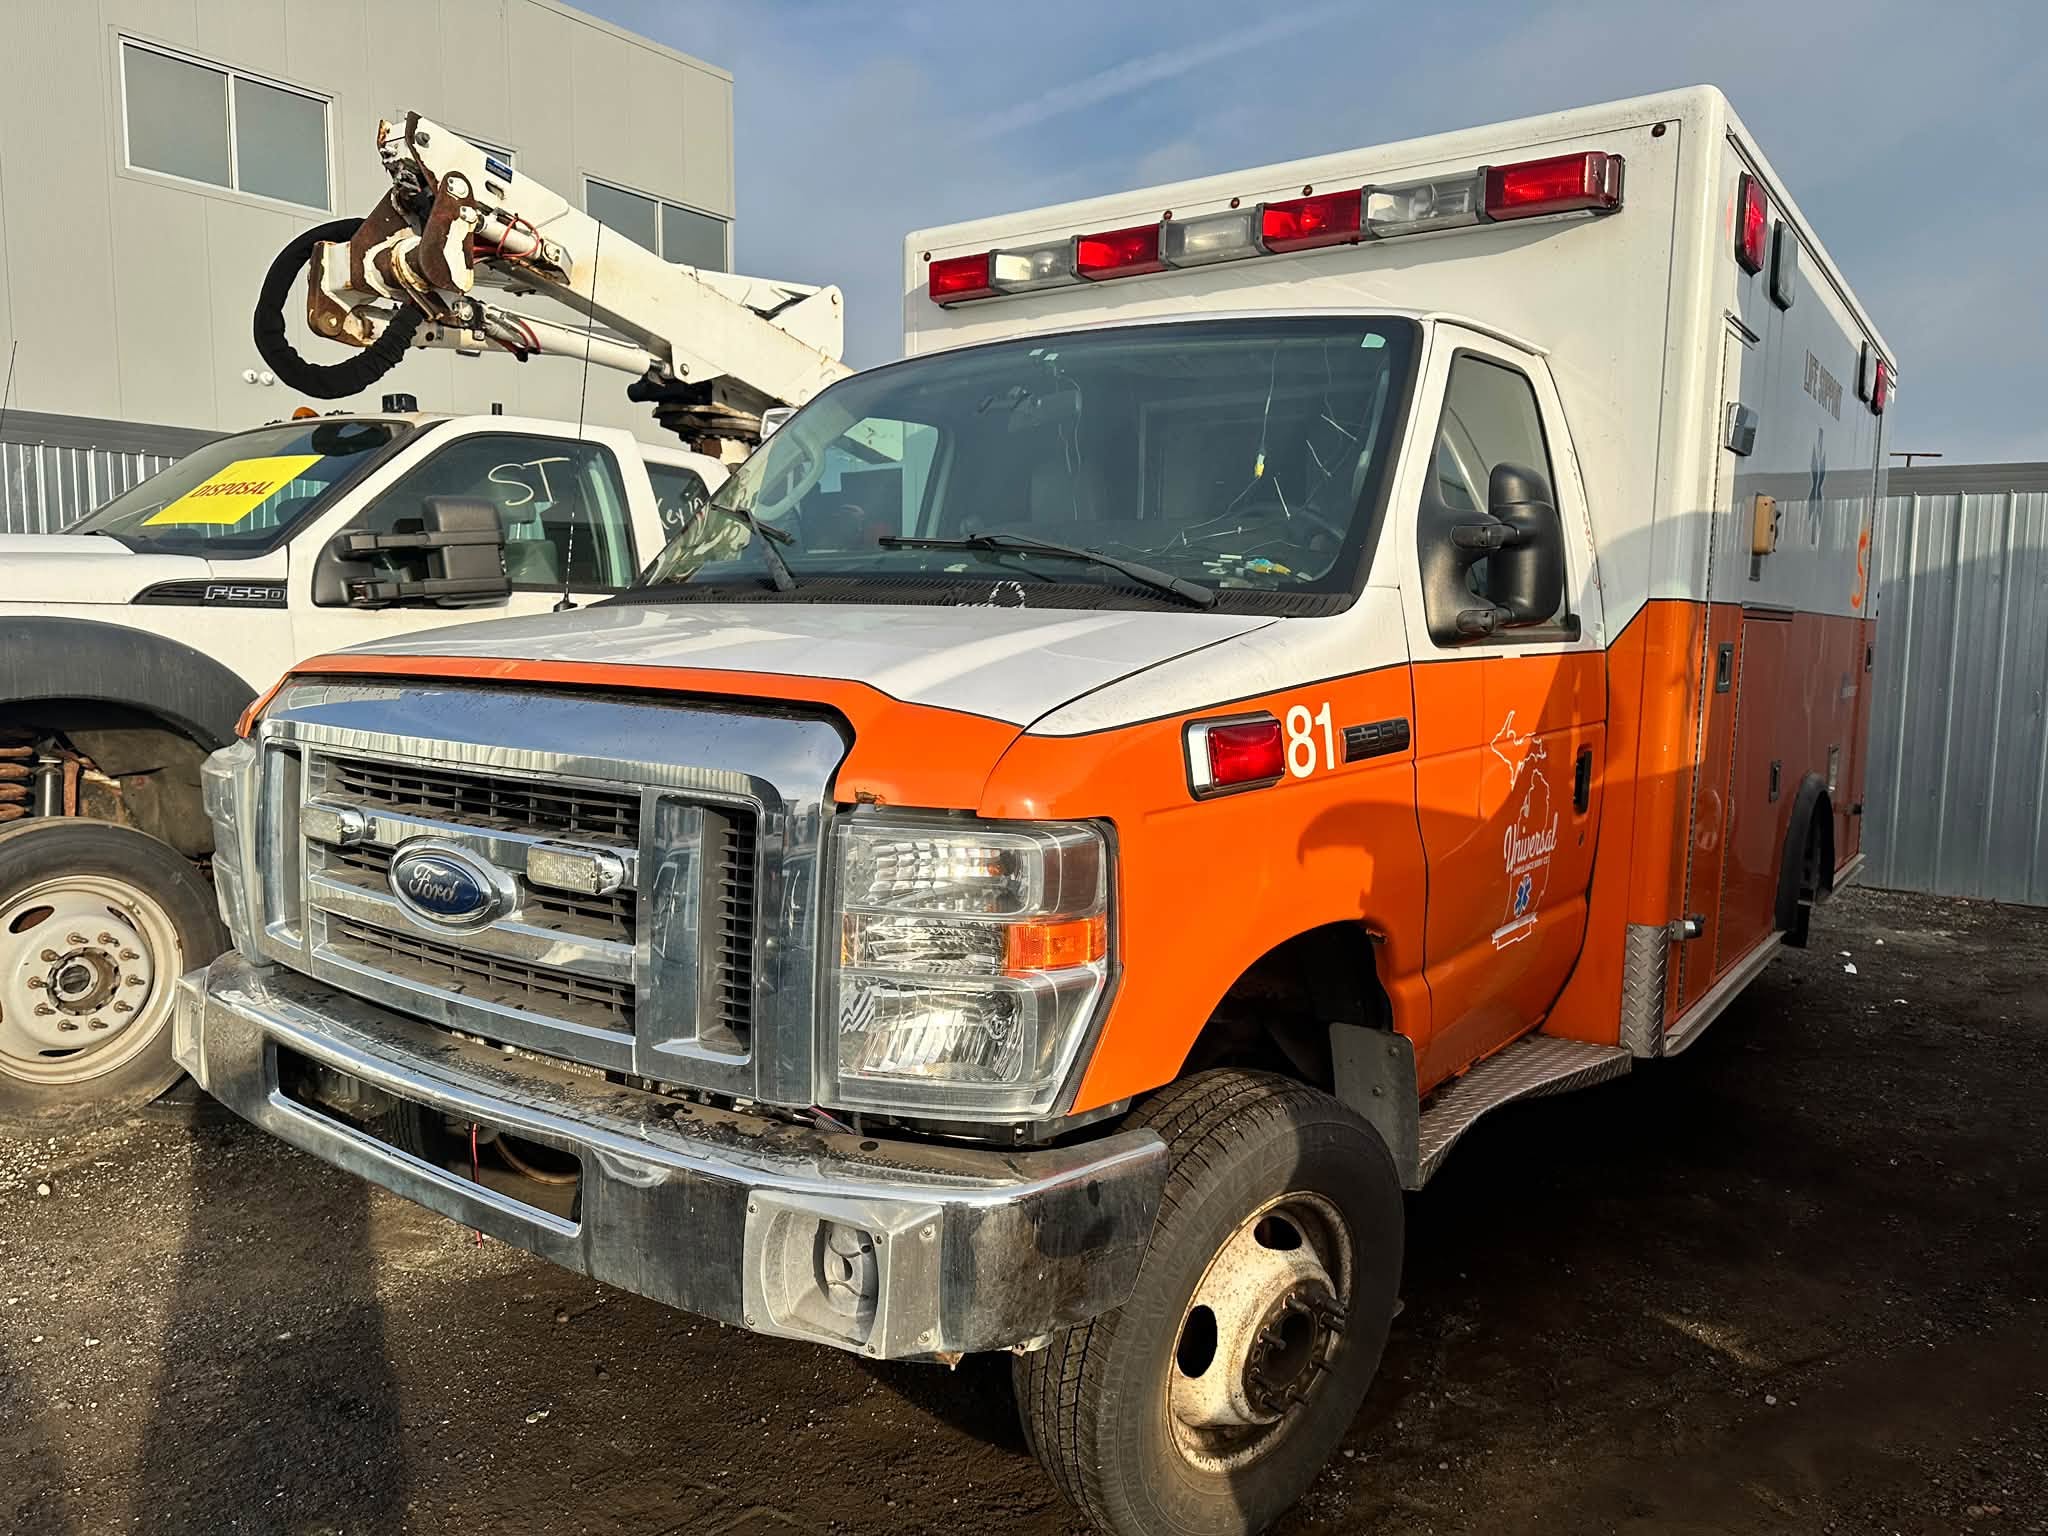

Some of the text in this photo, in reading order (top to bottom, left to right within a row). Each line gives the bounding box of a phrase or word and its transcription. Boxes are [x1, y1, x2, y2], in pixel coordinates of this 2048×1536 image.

[190, 480, 275, 498] DISPOSAL
[1286, 701, 1336, 779] 81
[1504, 811, 1558, 874] Universal
[408, 863, 460, 901] Ford
